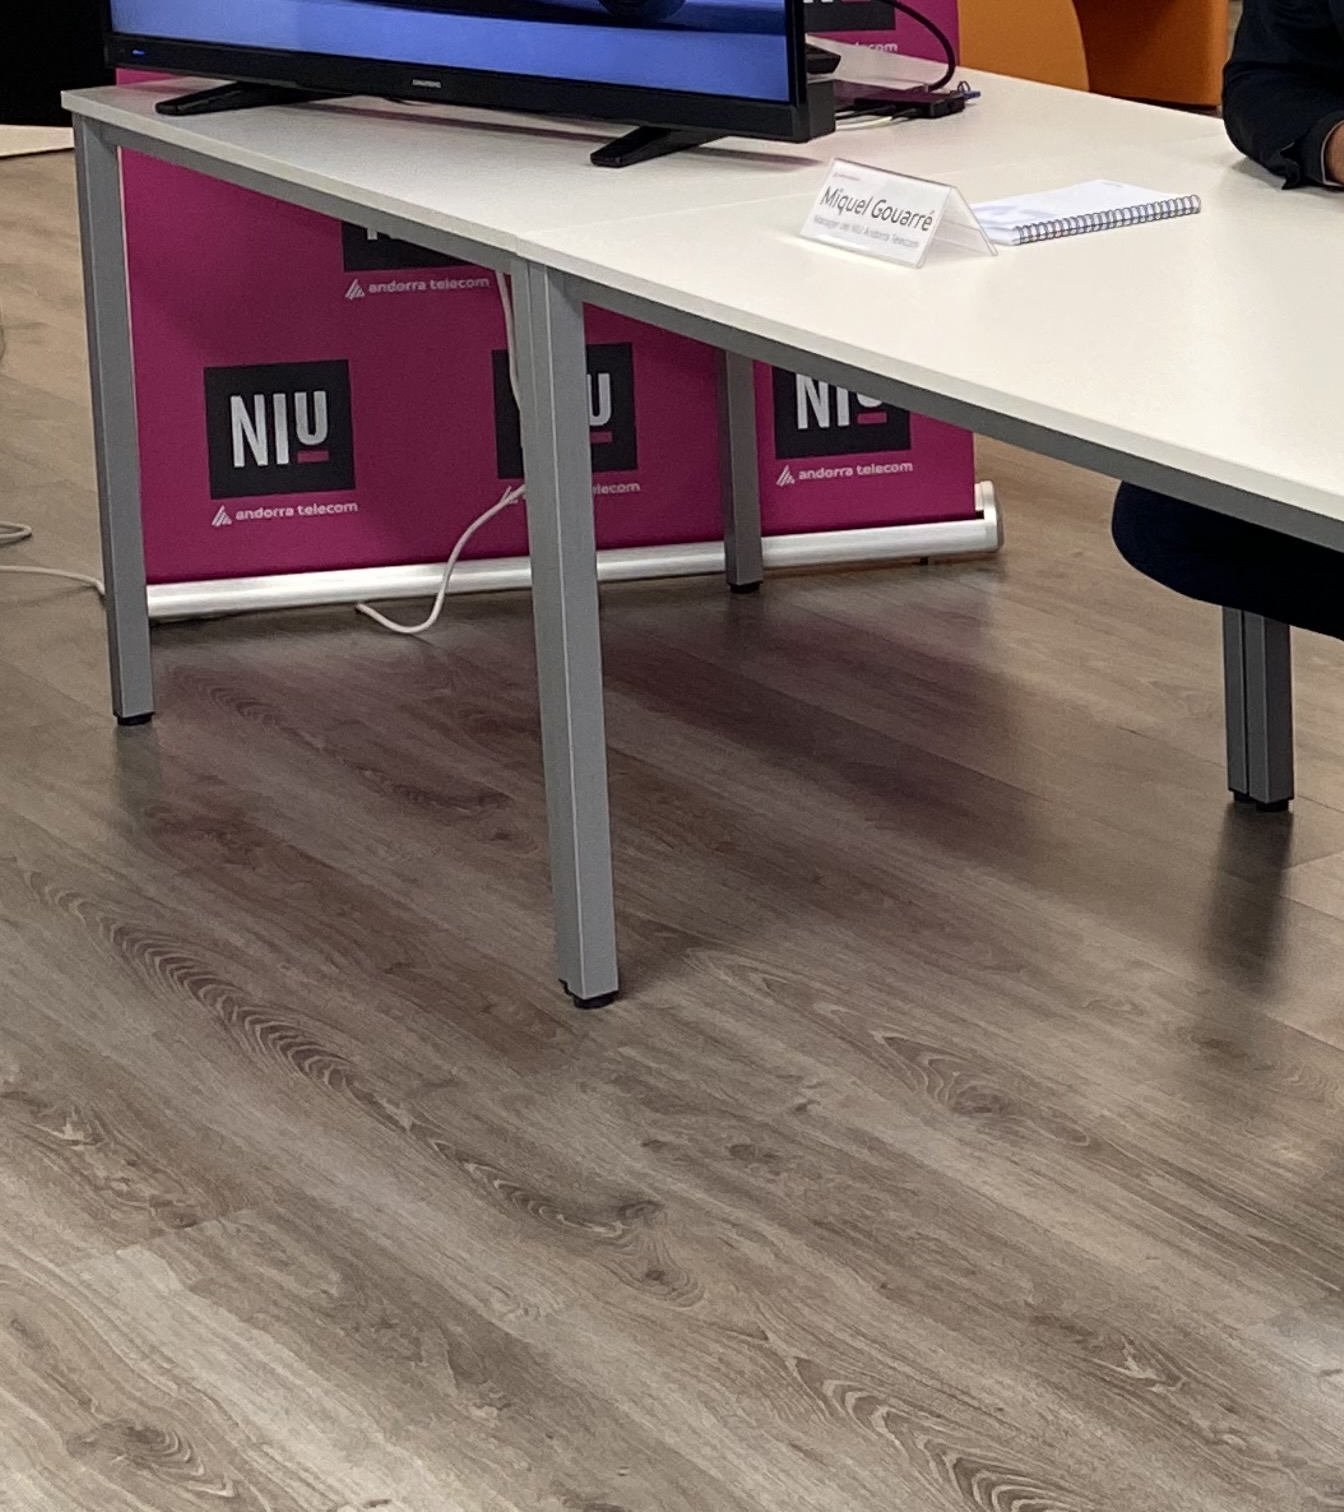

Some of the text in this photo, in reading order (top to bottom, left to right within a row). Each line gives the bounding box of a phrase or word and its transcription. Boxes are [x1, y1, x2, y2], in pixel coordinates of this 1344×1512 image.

[820, 186, 935, 232] Miquel Gouarré
[367, 278, 490, 294] andorra telecom
[231, 391, 327, 467] NIU
[798, 462, 914, 480] andorra telecom
[592, 482, 641, 495] elecom
[235, 502, 358, 521] andorra telecom
